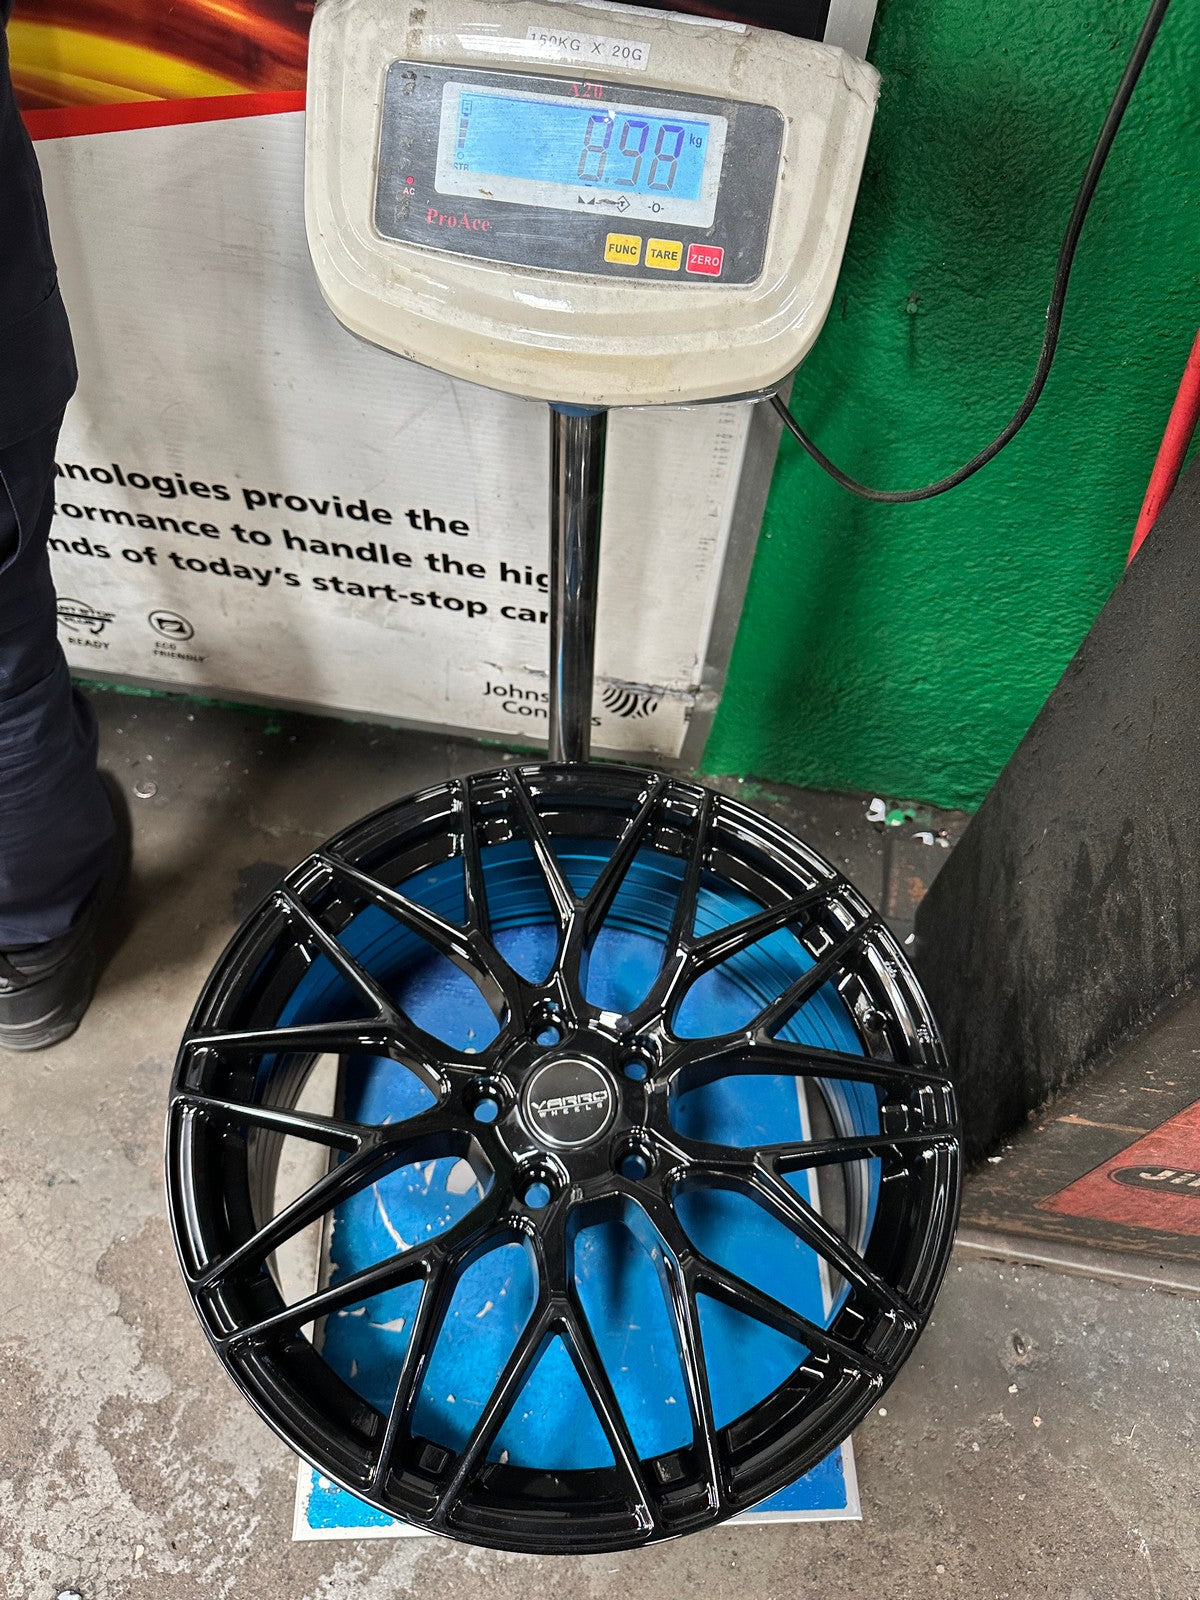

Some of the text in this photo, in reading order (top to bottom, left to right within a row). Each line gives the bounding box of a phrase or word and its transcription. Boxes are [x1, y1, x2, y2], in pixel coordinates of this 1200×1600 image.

[591, 42, 602, 55] X
[612, 45, 643, 61] 20G
[577, 115, 703, 191] 8.98 kg
[453, 161, 470, 172] STR
[402, 186, 416, 195] AC
[426, 207, 492, 231] ProAce
[608, 243, 720, 267] FUNC TARE ZERO
[242, 488, 393, 525] provide
[405, 509, 470, 536] the
[53, 502, 220, 539] ormance
[231, 524, 272, 546] to
[283, 529, 412, 567] handle
[425, 553, 486, 578] the
[122, 546, 157, 566] of
[169, 552, 301, 587] today's
[312, 576, 488, 618] start-stop
[484, 682, 549, 702] Johns
